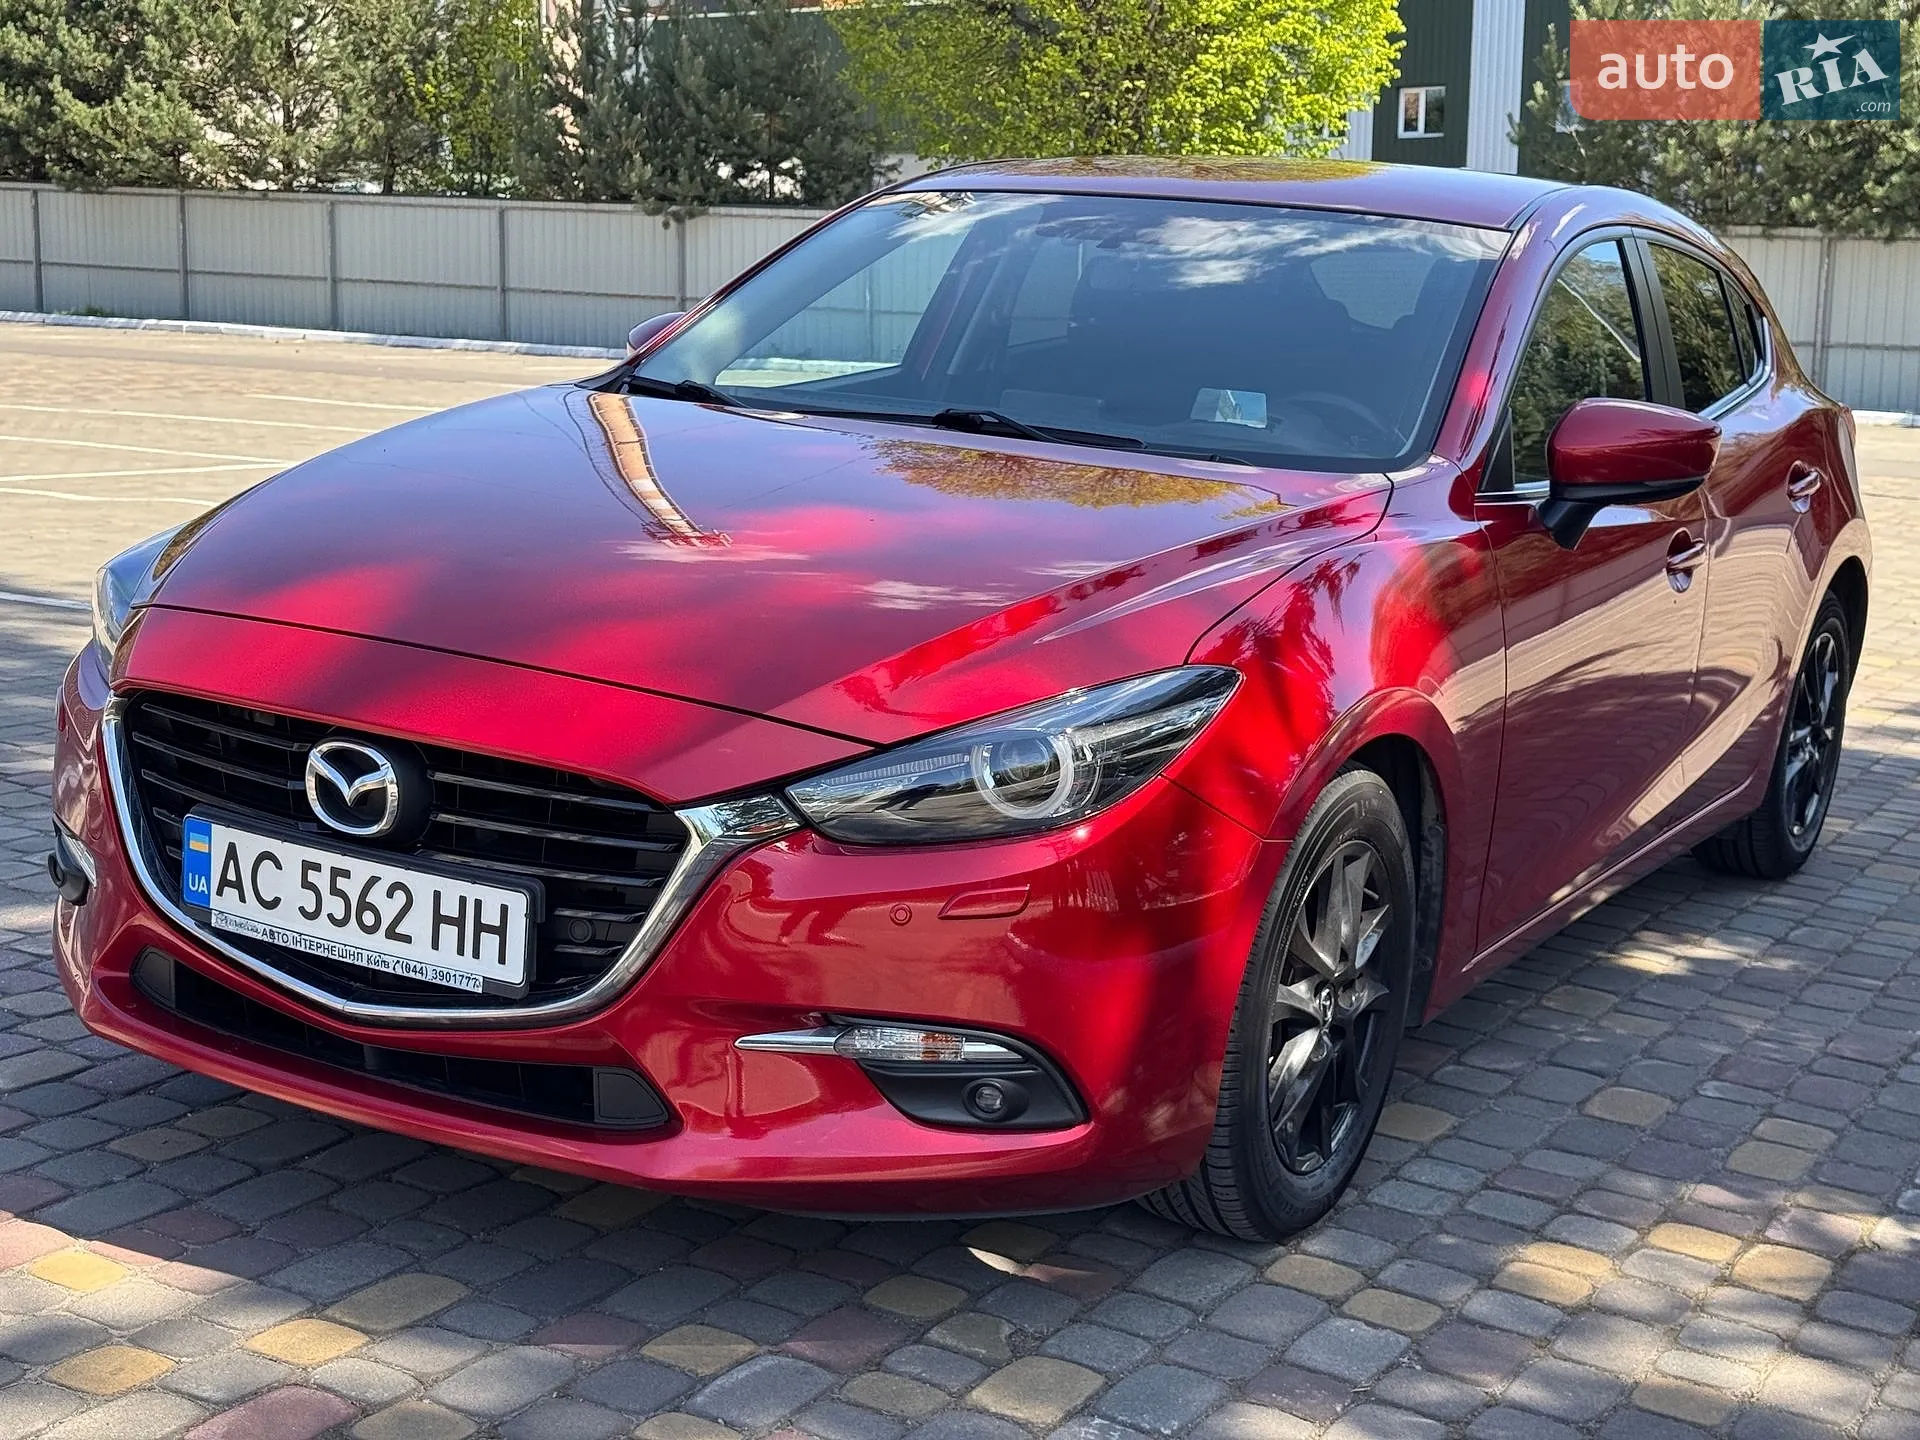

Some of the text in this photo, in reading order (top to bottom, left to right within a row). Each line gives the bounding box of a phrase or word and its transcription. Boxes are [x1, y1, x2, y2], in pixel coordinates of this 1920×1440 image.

[189, 873, 208, 895] UA
[216, 842, 509, 966] AC 5562 HH
[261, 927, 290, 944] АВТО
